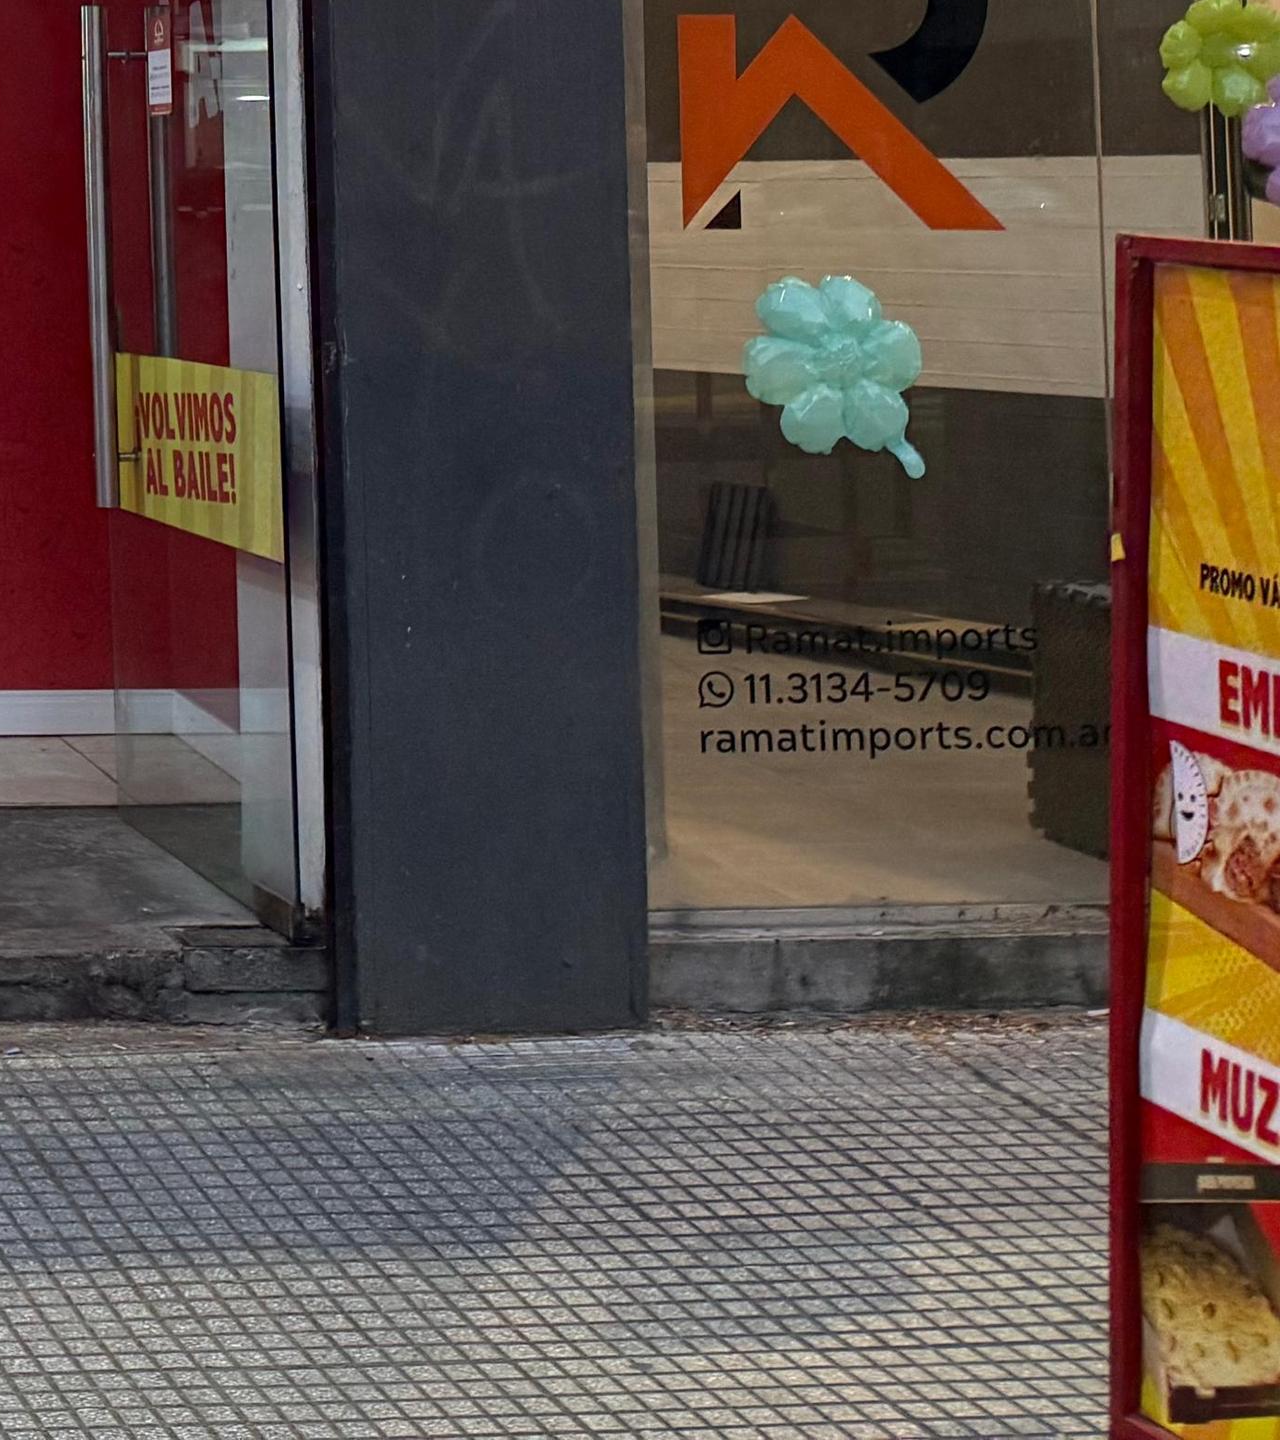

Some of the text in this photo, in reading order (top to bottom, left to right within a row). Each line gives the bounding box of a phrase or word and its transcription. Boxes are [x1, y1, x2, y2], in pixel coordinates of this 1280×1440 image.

[146, 448, 237, 505] AL BAILE!
[1200, 563, 1255, 602] PROMO
[745, 621, 1038, 659] Ramat.imports
[744, 670, 990, 705] 11.3134-5709
